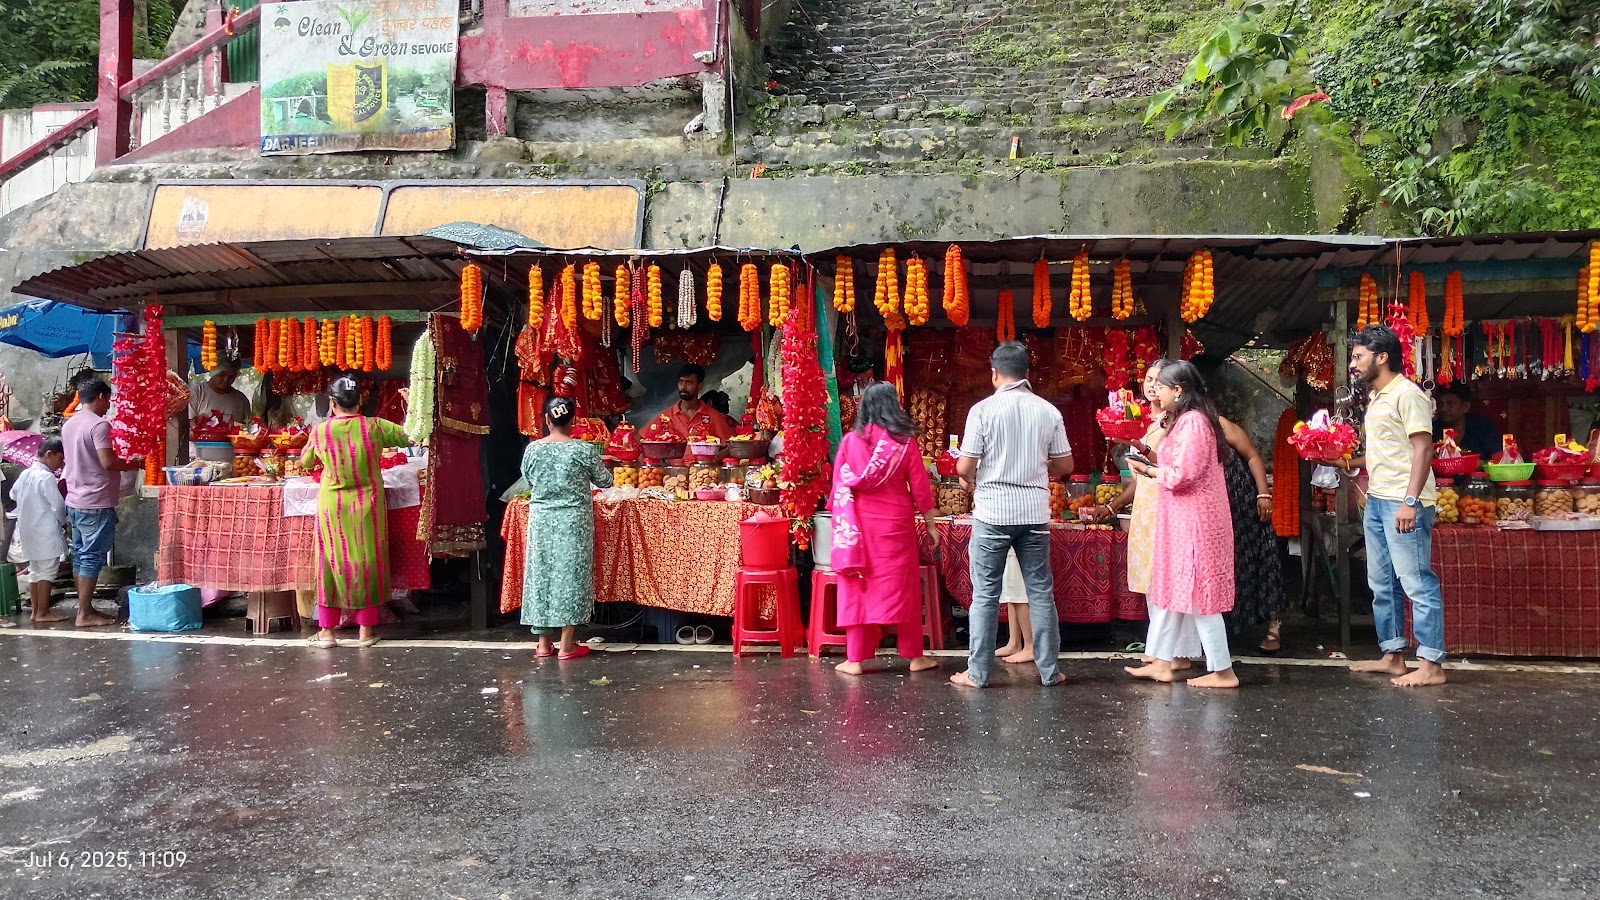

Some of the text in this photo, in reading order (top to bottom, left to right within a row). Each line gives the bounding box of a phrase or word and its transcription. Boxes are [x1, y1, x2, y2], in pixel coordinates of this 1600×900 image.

[297, 16, 342, 37] Clean
[338, 34, 453, 58] & Green SEVOKE
[366, 88, 382, 111] POLICE
